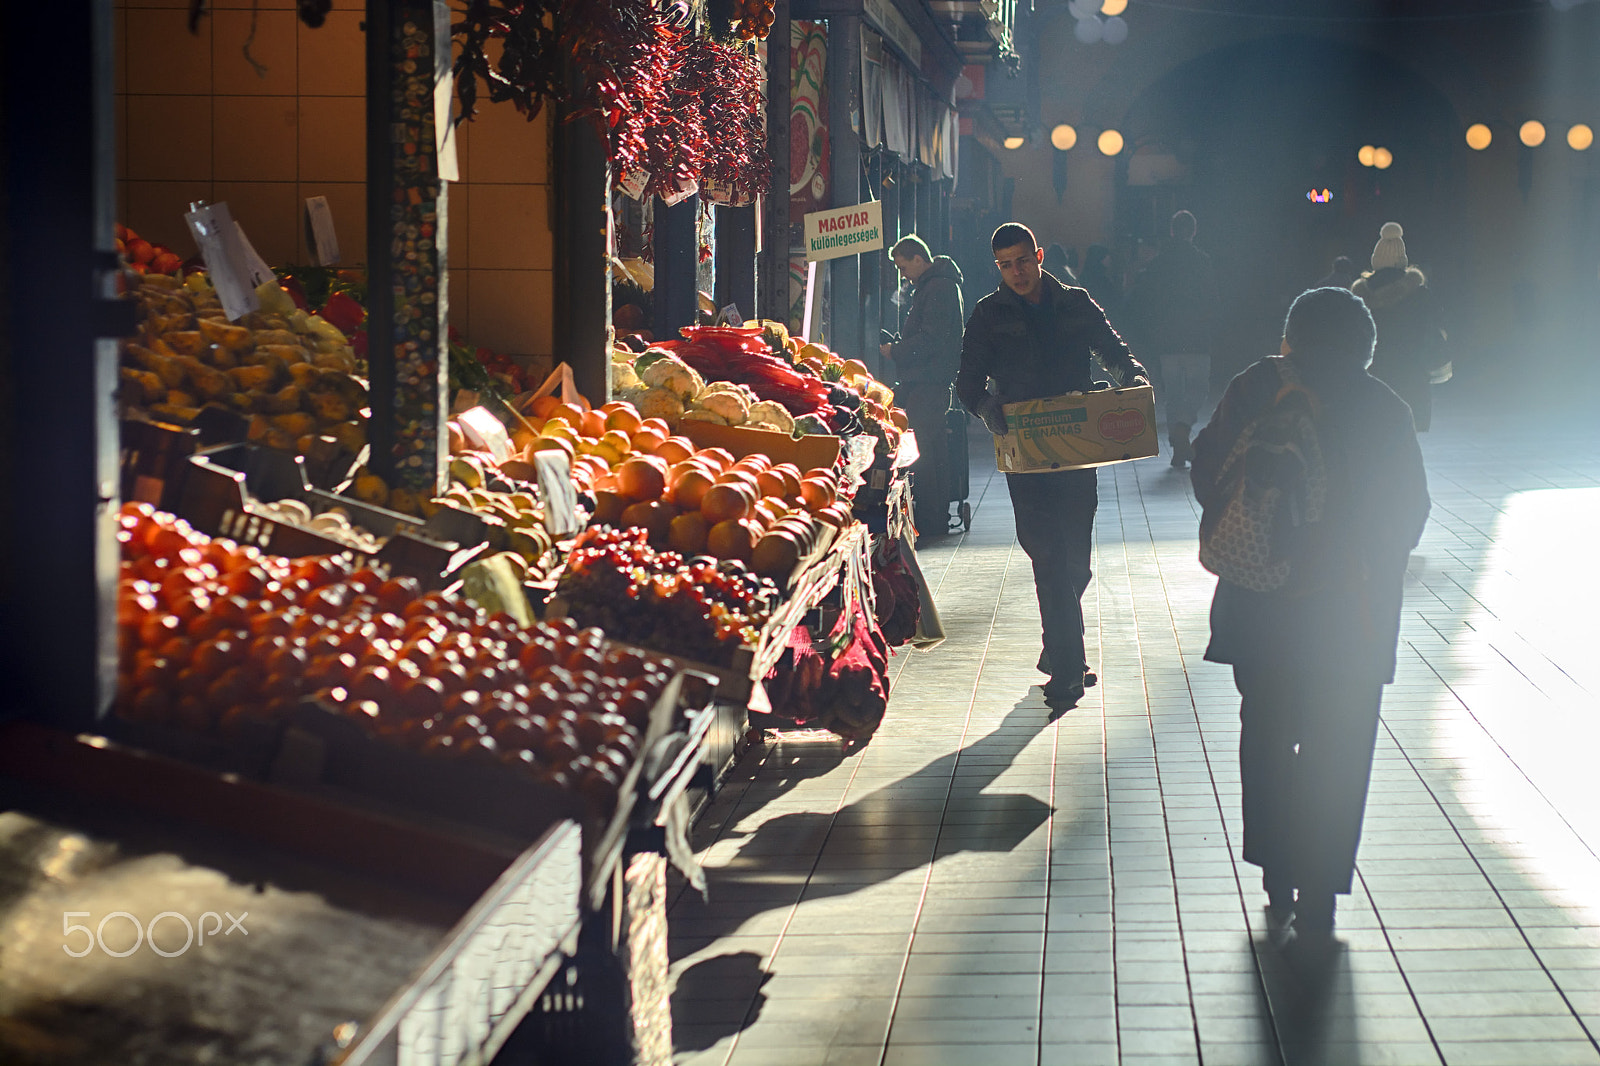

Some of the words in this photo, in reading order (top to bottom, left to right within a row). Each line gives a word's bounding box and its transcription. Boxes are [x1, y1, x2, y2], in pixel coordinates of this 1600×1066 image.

[818, 211, 869, 234] MAGYAR
[810, 226, 879, 252] különlegességek
[1022, 413, 1072, 427] Premium
[1023, 424, 1082, 440] BANANAS
